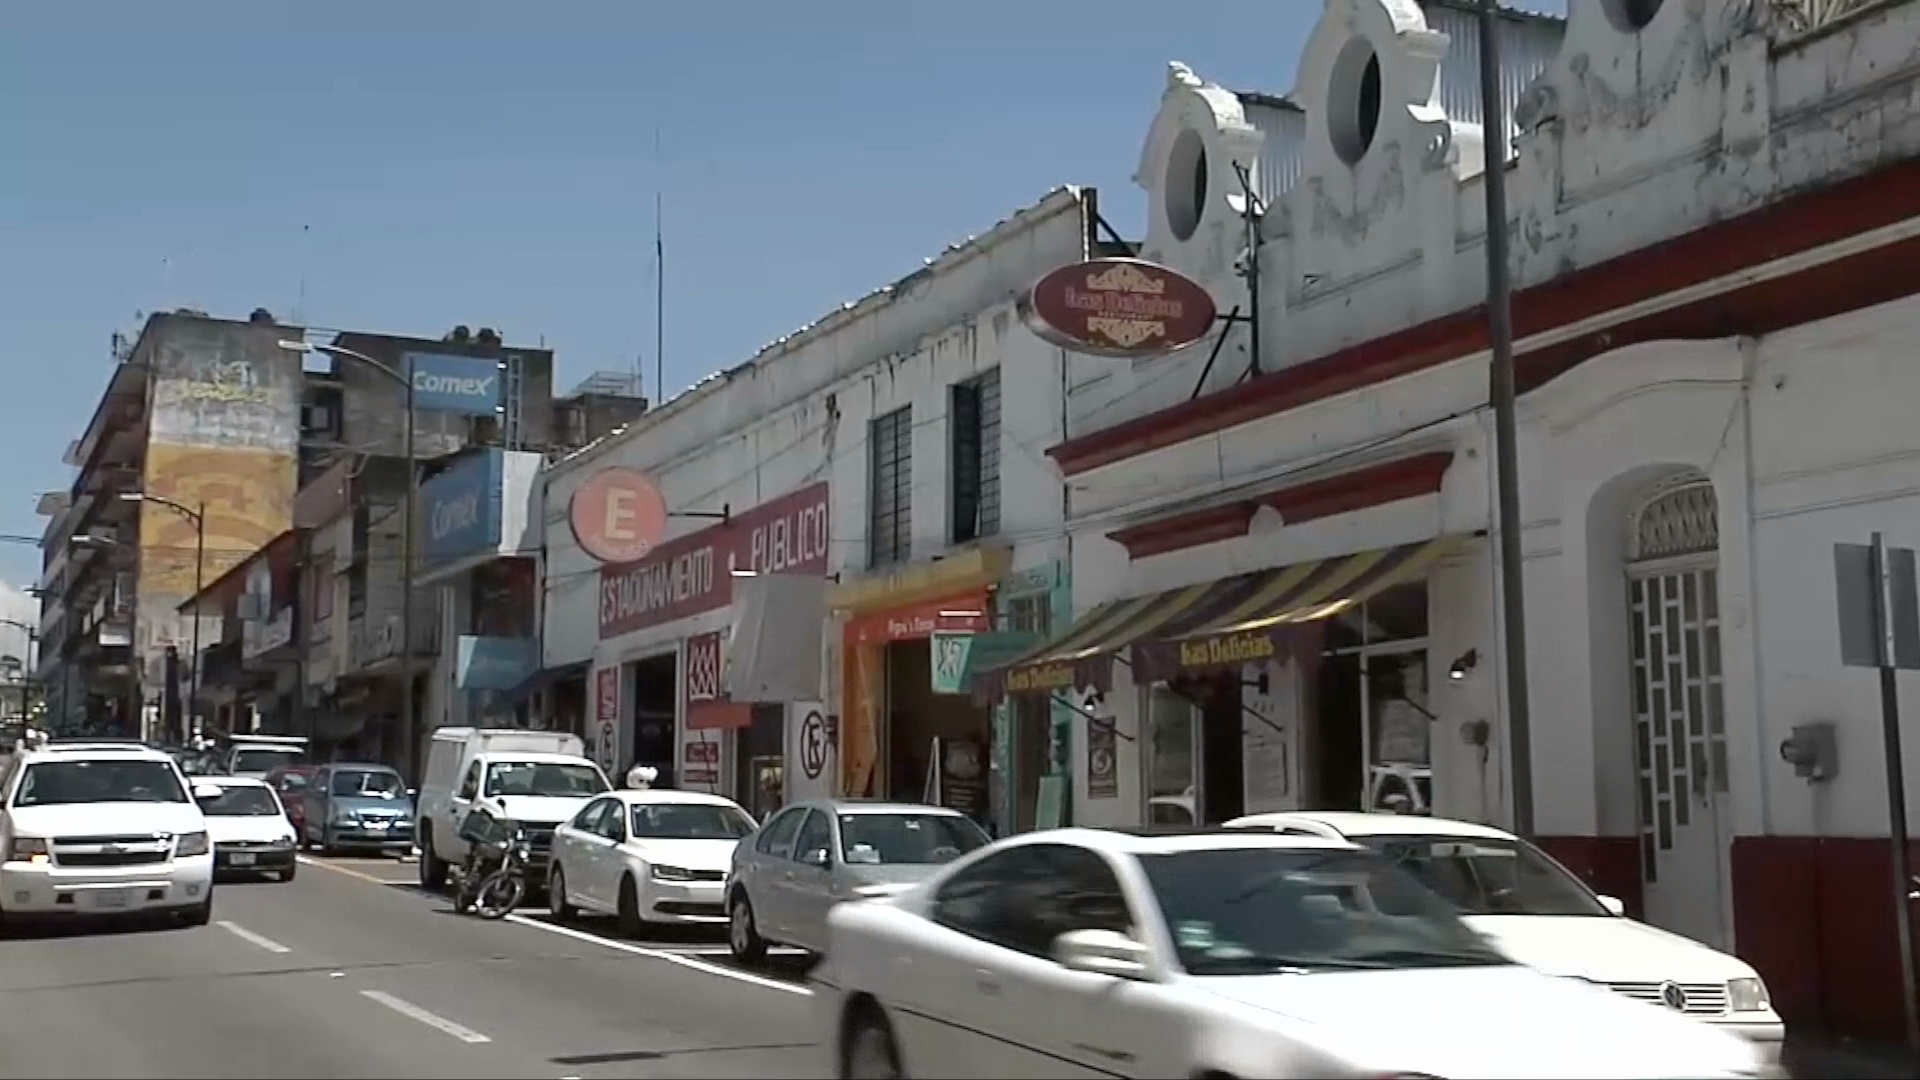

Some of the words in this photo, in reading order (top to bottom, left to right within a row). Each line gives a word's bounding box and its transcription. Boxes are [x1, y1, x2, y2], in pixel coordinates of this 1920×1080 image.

[413, 370, 494, 397] Comex
[604, 487, 637, 539] E
[1209, 631, 1274, 664] Delicias
